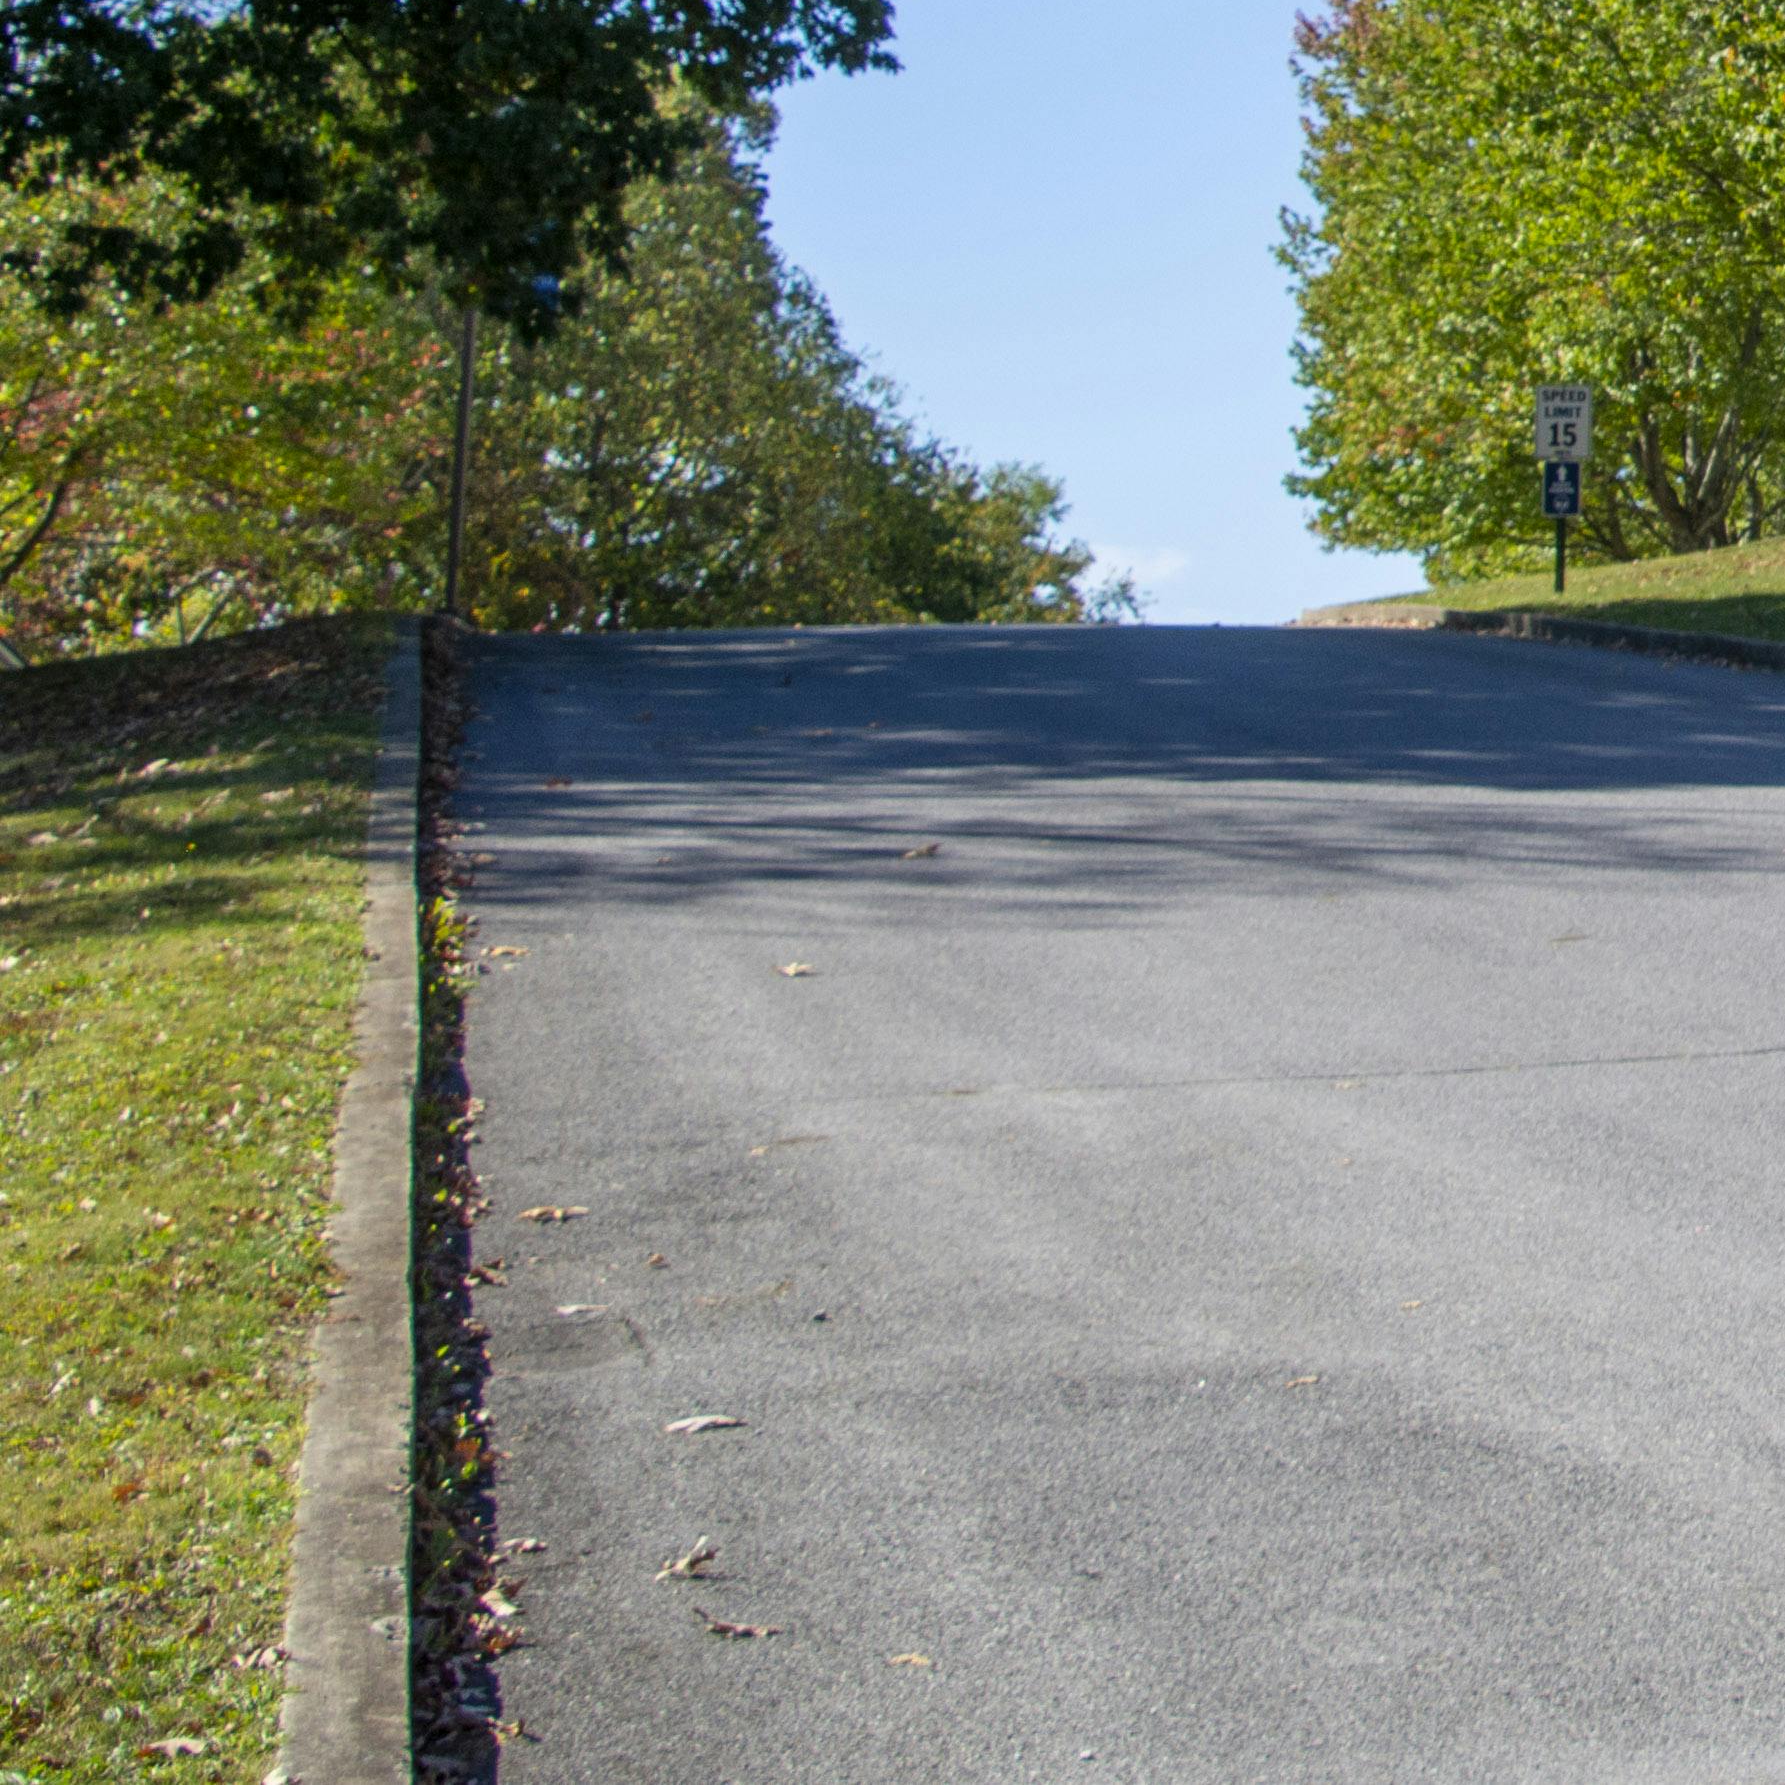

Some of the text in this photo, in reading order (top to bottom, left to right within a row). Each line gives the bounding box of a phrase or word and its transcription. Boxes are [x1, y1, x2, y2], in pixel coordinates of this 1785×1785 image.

[1541, 390, 1586, 402] SPEED
[1545, 407, 1581, 418] LIMIT
[1549, 423, 1577, 447] 15
